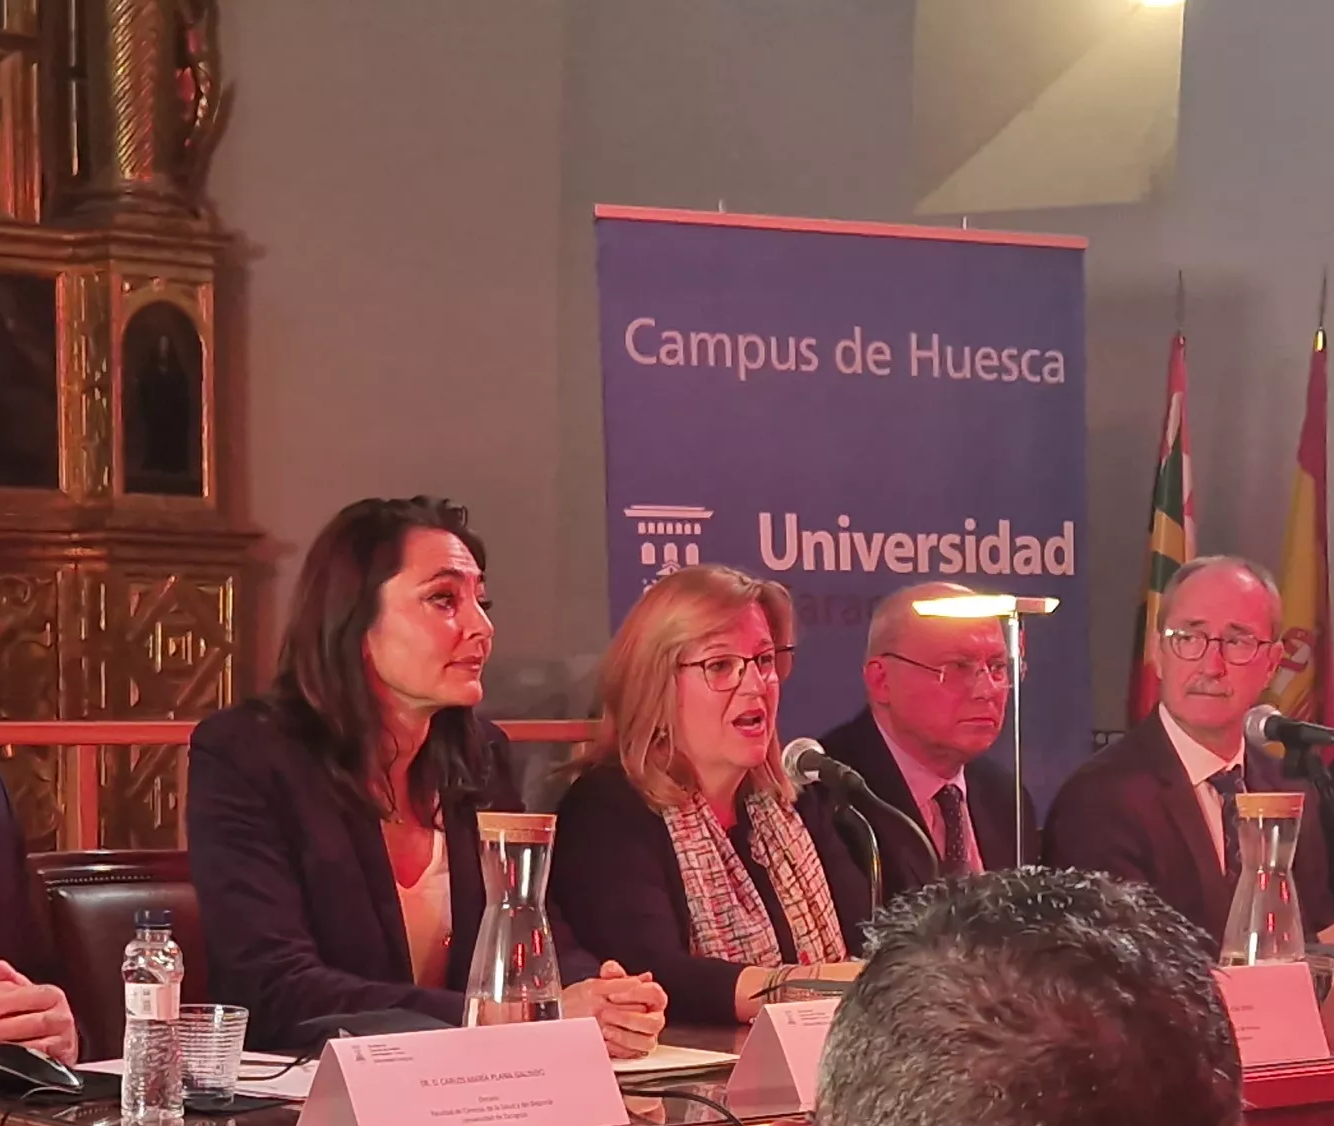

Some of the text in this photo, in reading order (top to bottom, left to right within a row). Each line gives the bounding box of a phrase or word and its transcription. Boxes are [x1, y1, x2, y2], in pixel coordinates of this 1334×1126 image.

[624, 317, 1066, 384] Campus de Huesca
[758, 512, 1076, 577] Universidad
